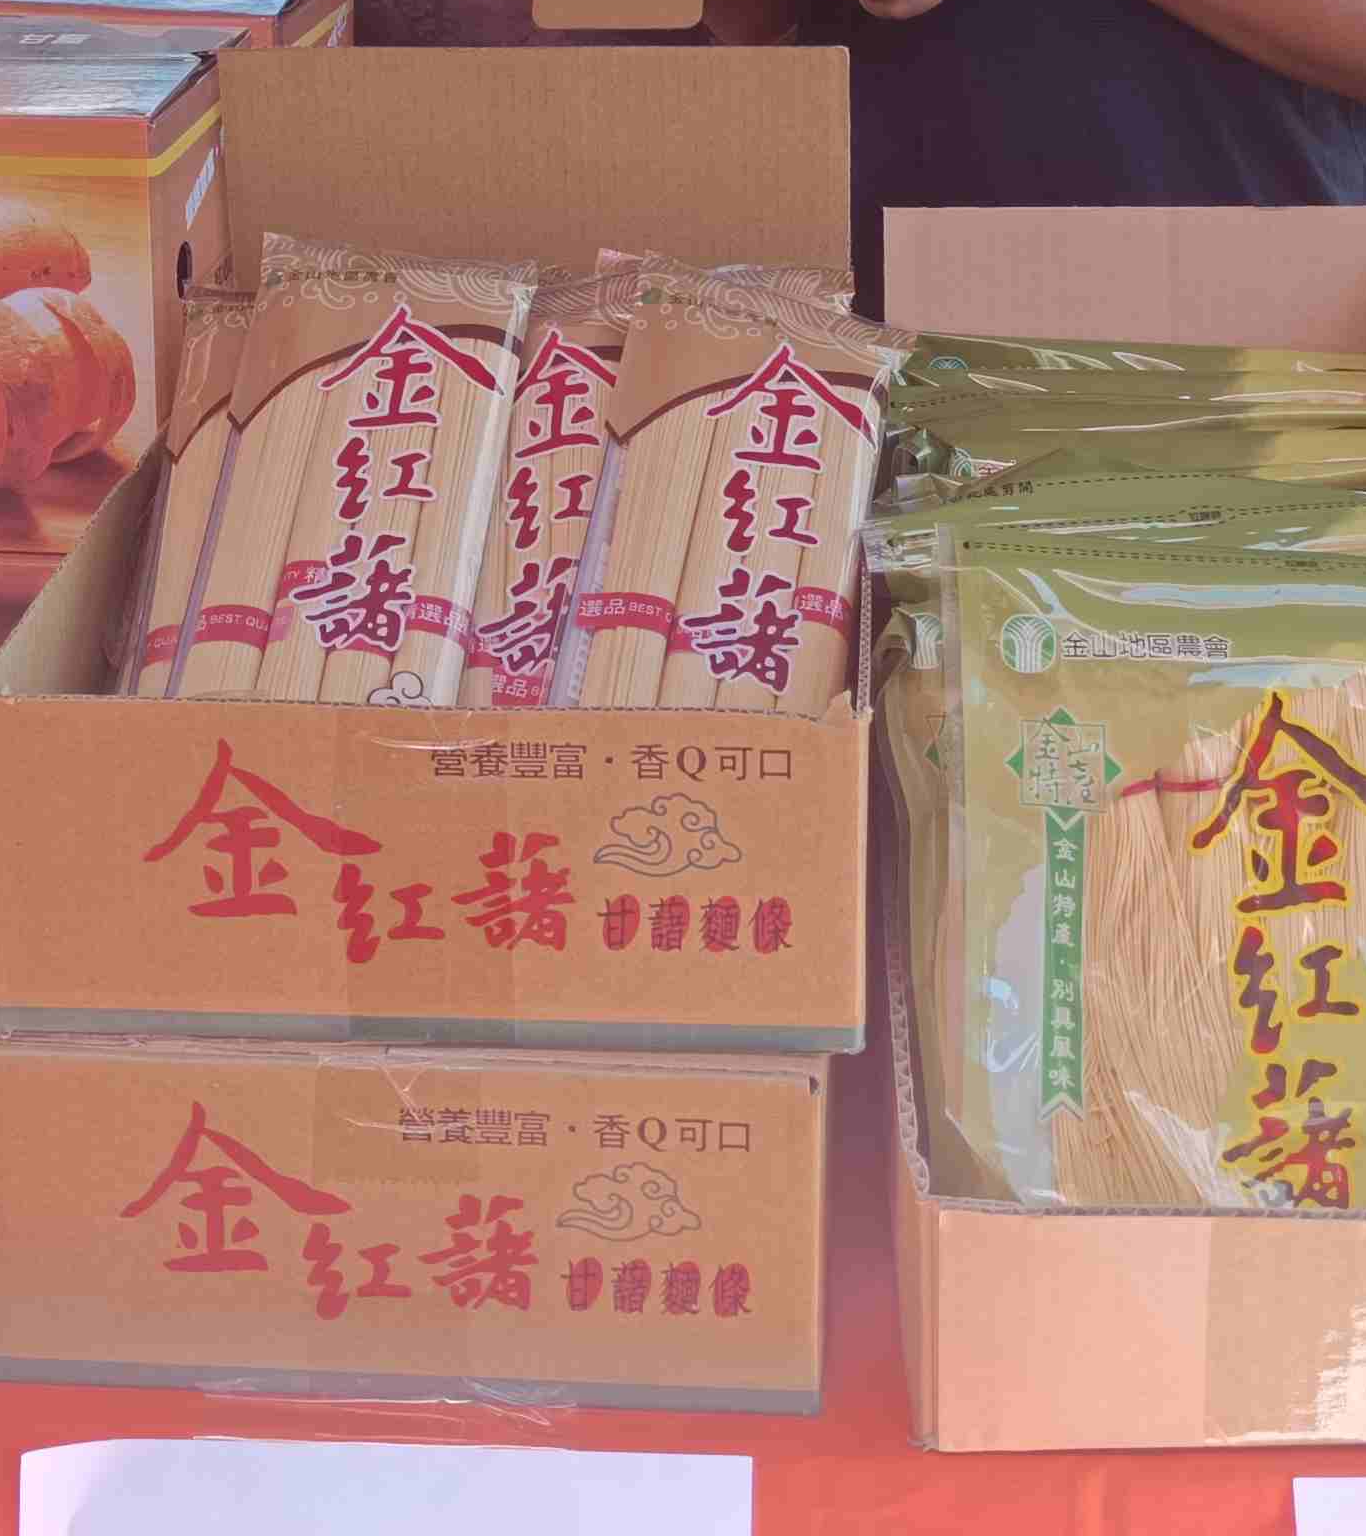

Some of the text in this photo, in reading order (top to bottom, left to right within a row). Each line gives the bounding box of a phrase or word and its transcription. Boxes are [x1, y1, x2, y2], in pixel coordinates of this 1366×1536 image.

[292, 306, 504, 650] 金紅藷
[682, 345, 875, 693] 金紅藷
[209, 614, 242, 626] BEST
[628, 602, 663, 617] BEST
[1063, 631, 1229, 659] 金山地區農會
[143, 737, 575, 964] 金紅藷
[119, 1100, 539, 1321] 金紅藷
